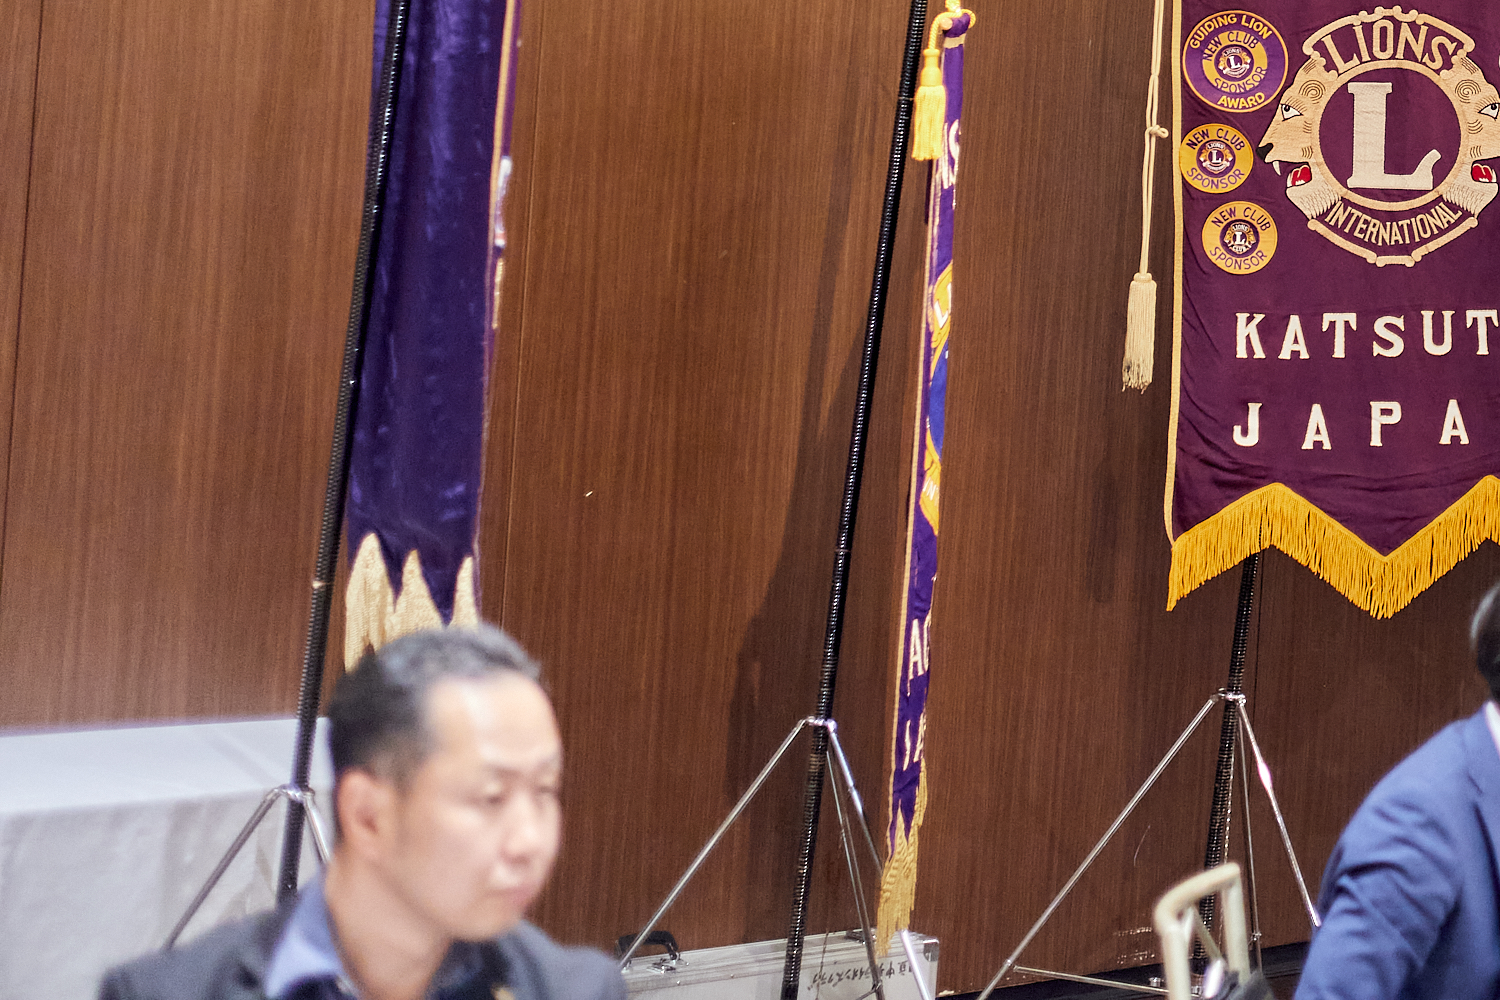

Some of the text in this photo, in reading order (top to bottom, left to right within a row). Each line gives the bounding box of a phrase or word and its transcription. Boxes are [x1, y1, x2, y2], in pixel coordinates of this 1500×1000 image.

[1189, 14, 1272, 48] GUIDING LION
[1203, 31, 1259, 62] NEW CLUB
[1321, 19, 1458, 74] LIONS
[1228, 55, 1241, 69] L
[1214, 66, 1267, 93] SPONSOR
[1217, 92, 1265, 109] AWARD
[1185, 128, 1246, 151] NEW CLUB
[1346, 81, 1442, 191] L
[1211, 150, 1222, 162] L
[1186, 167, 1245, 190] SPONSOR
[1211, 206, 1272, 232] NEW CLUB
[1324, 200, 1463, 247] INTERNATIONAL
[1235, 231, 1246, 245] L
[1209, 246, 1268, 270] SPONSOR
[807, 960, 914, 991] 立中ライオンズクラブ
